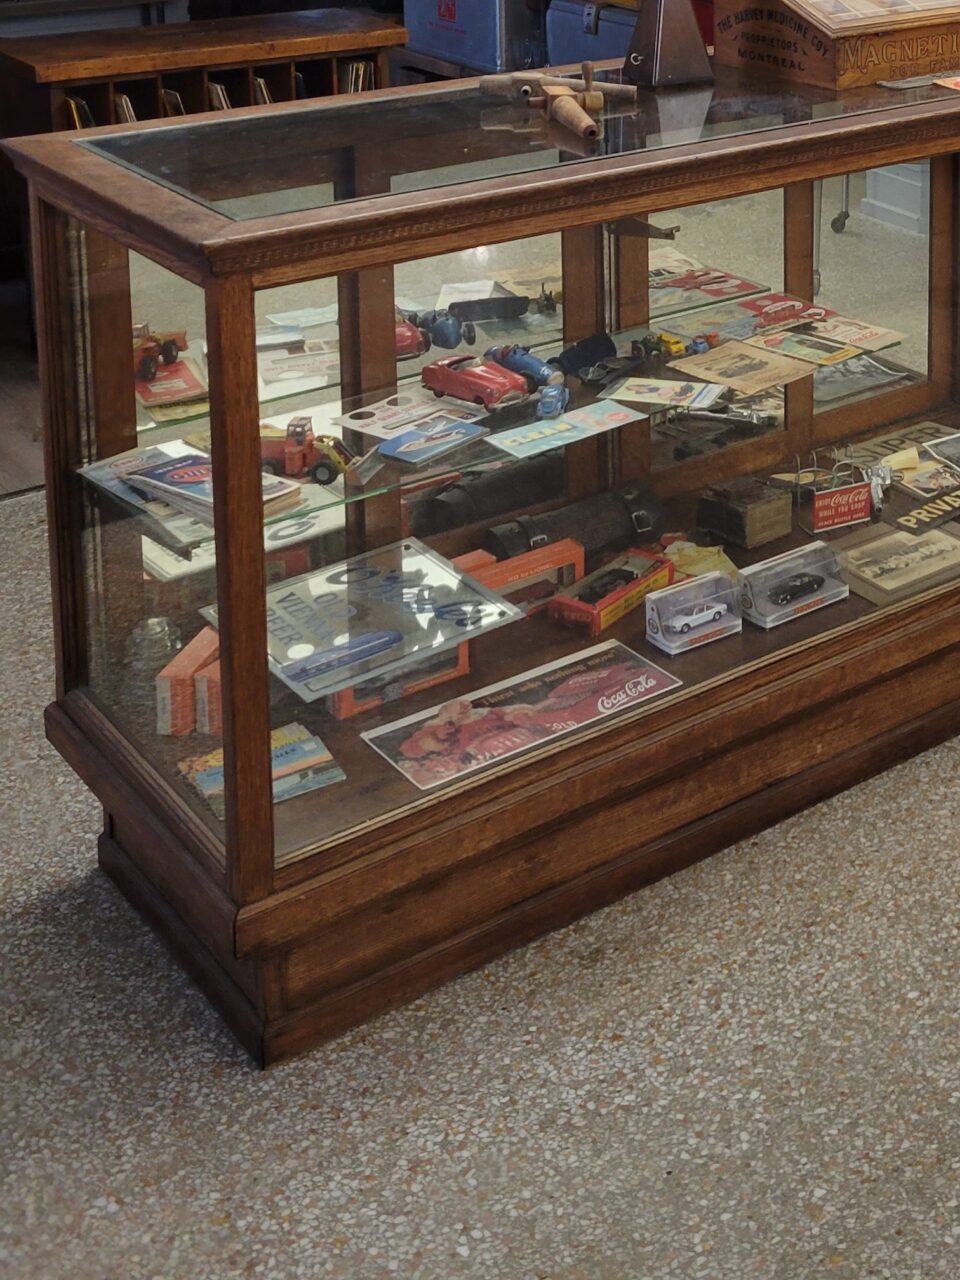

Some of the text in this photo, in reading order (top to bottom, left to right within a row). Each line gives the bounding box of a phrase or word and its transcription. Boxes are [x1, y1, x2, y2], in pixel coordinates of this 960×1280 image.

[717, 15, 733, 34] THE
[734, 7, 764, 26] HARVEY
[767, 8, 810, 40] MEDICINE
[741, 30, 799, 53] PROPRIETORS
[737, 47, 805, 72] MONTREAL
[889, 63, 922, 80] FOR
[503, 422, 577, 447] CLEAN
[845, 426, 943, 464] SUPER
[815, 497, 831, 508] ENJOY
[818, 501, 866, 518] WHILE YOU SHOP
[275, 591, 337, 642] VIENNA
[313, 591, 358, 617] OLD
